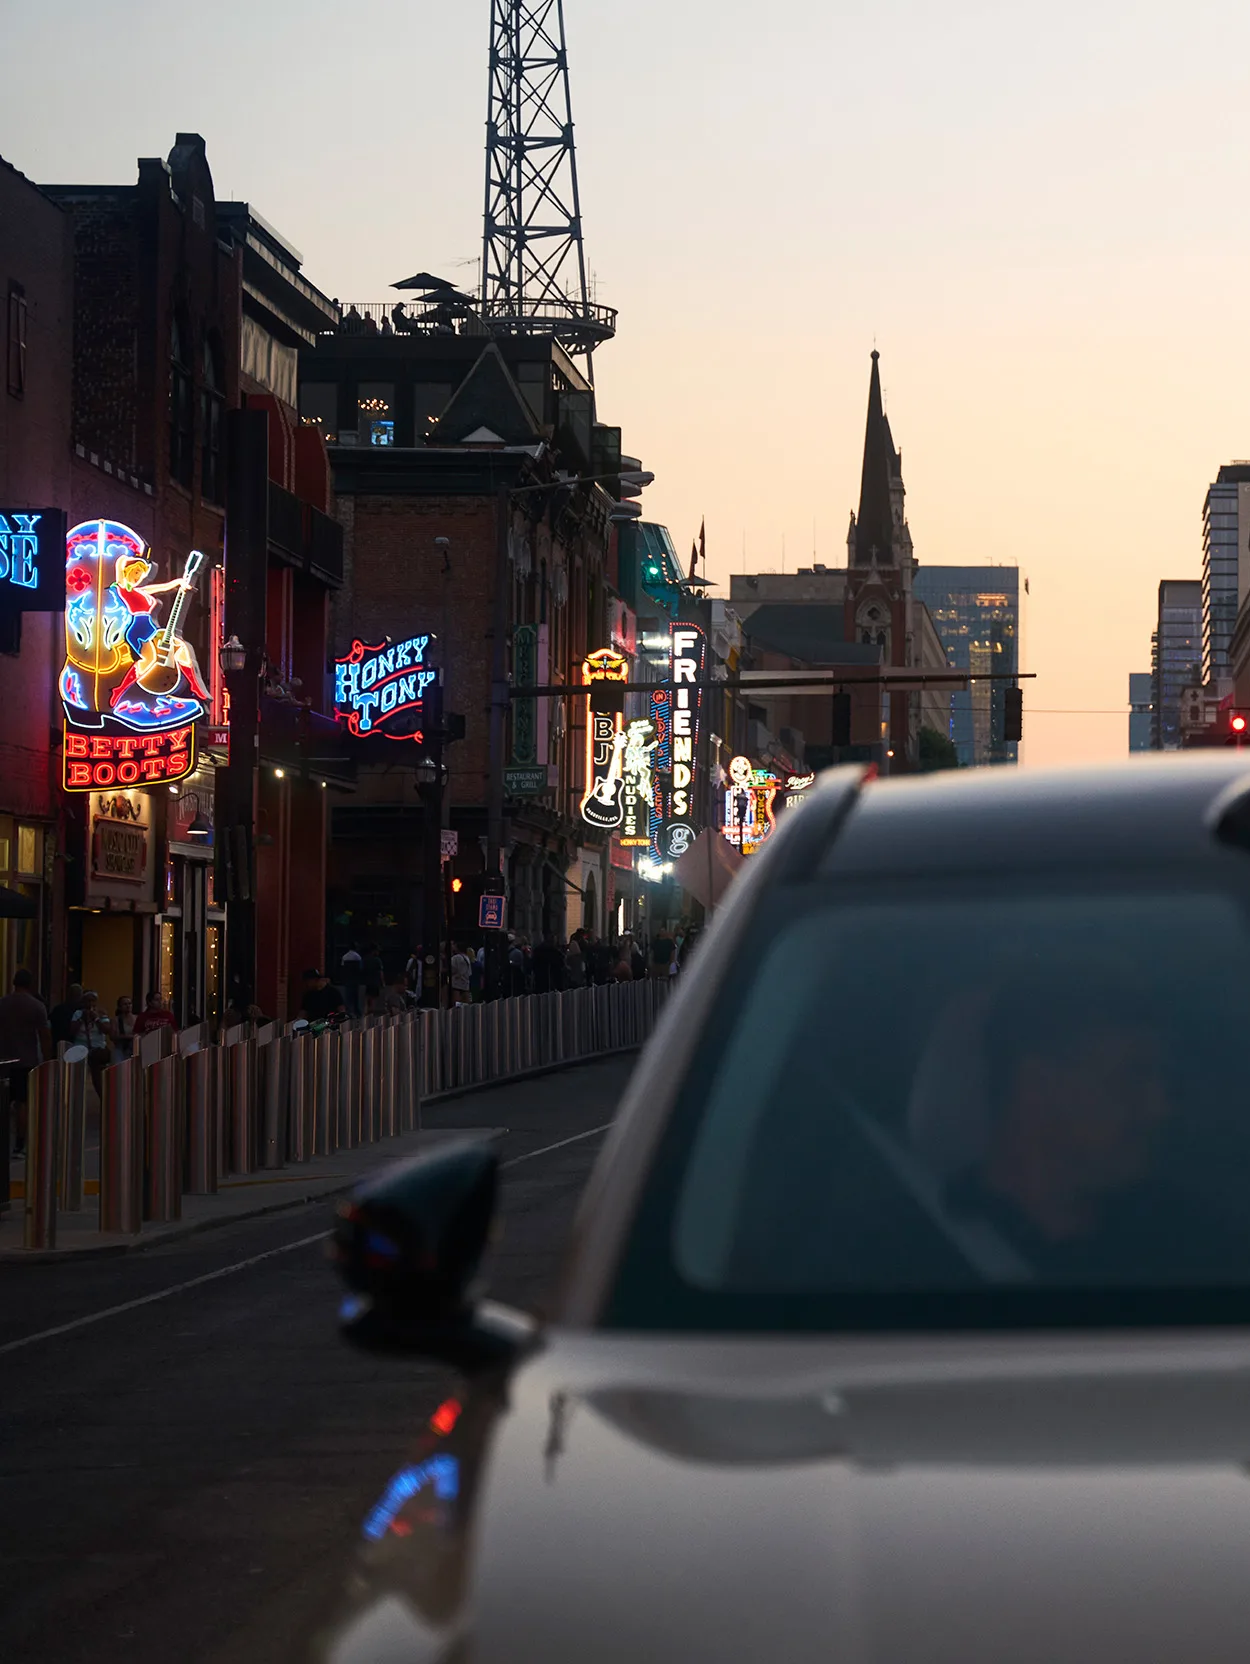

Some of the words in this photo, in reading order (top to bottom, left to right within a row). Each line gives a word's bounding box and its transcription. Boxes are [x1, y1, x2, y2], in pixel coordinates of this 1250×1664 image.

[335, 636, 429, 702] HONKY
[353, 671, 436, 730] TONK
[673, 631, 698, 816] FRIENDS
[66, 725, 192, 759] BETTY
[68, 751, 189, 786] BOOTS
[506, 772, 543, 781] RESTAURANT
[521, 781, 538, 789] GRILL
[625, 775, 637, 836] NUDIES
